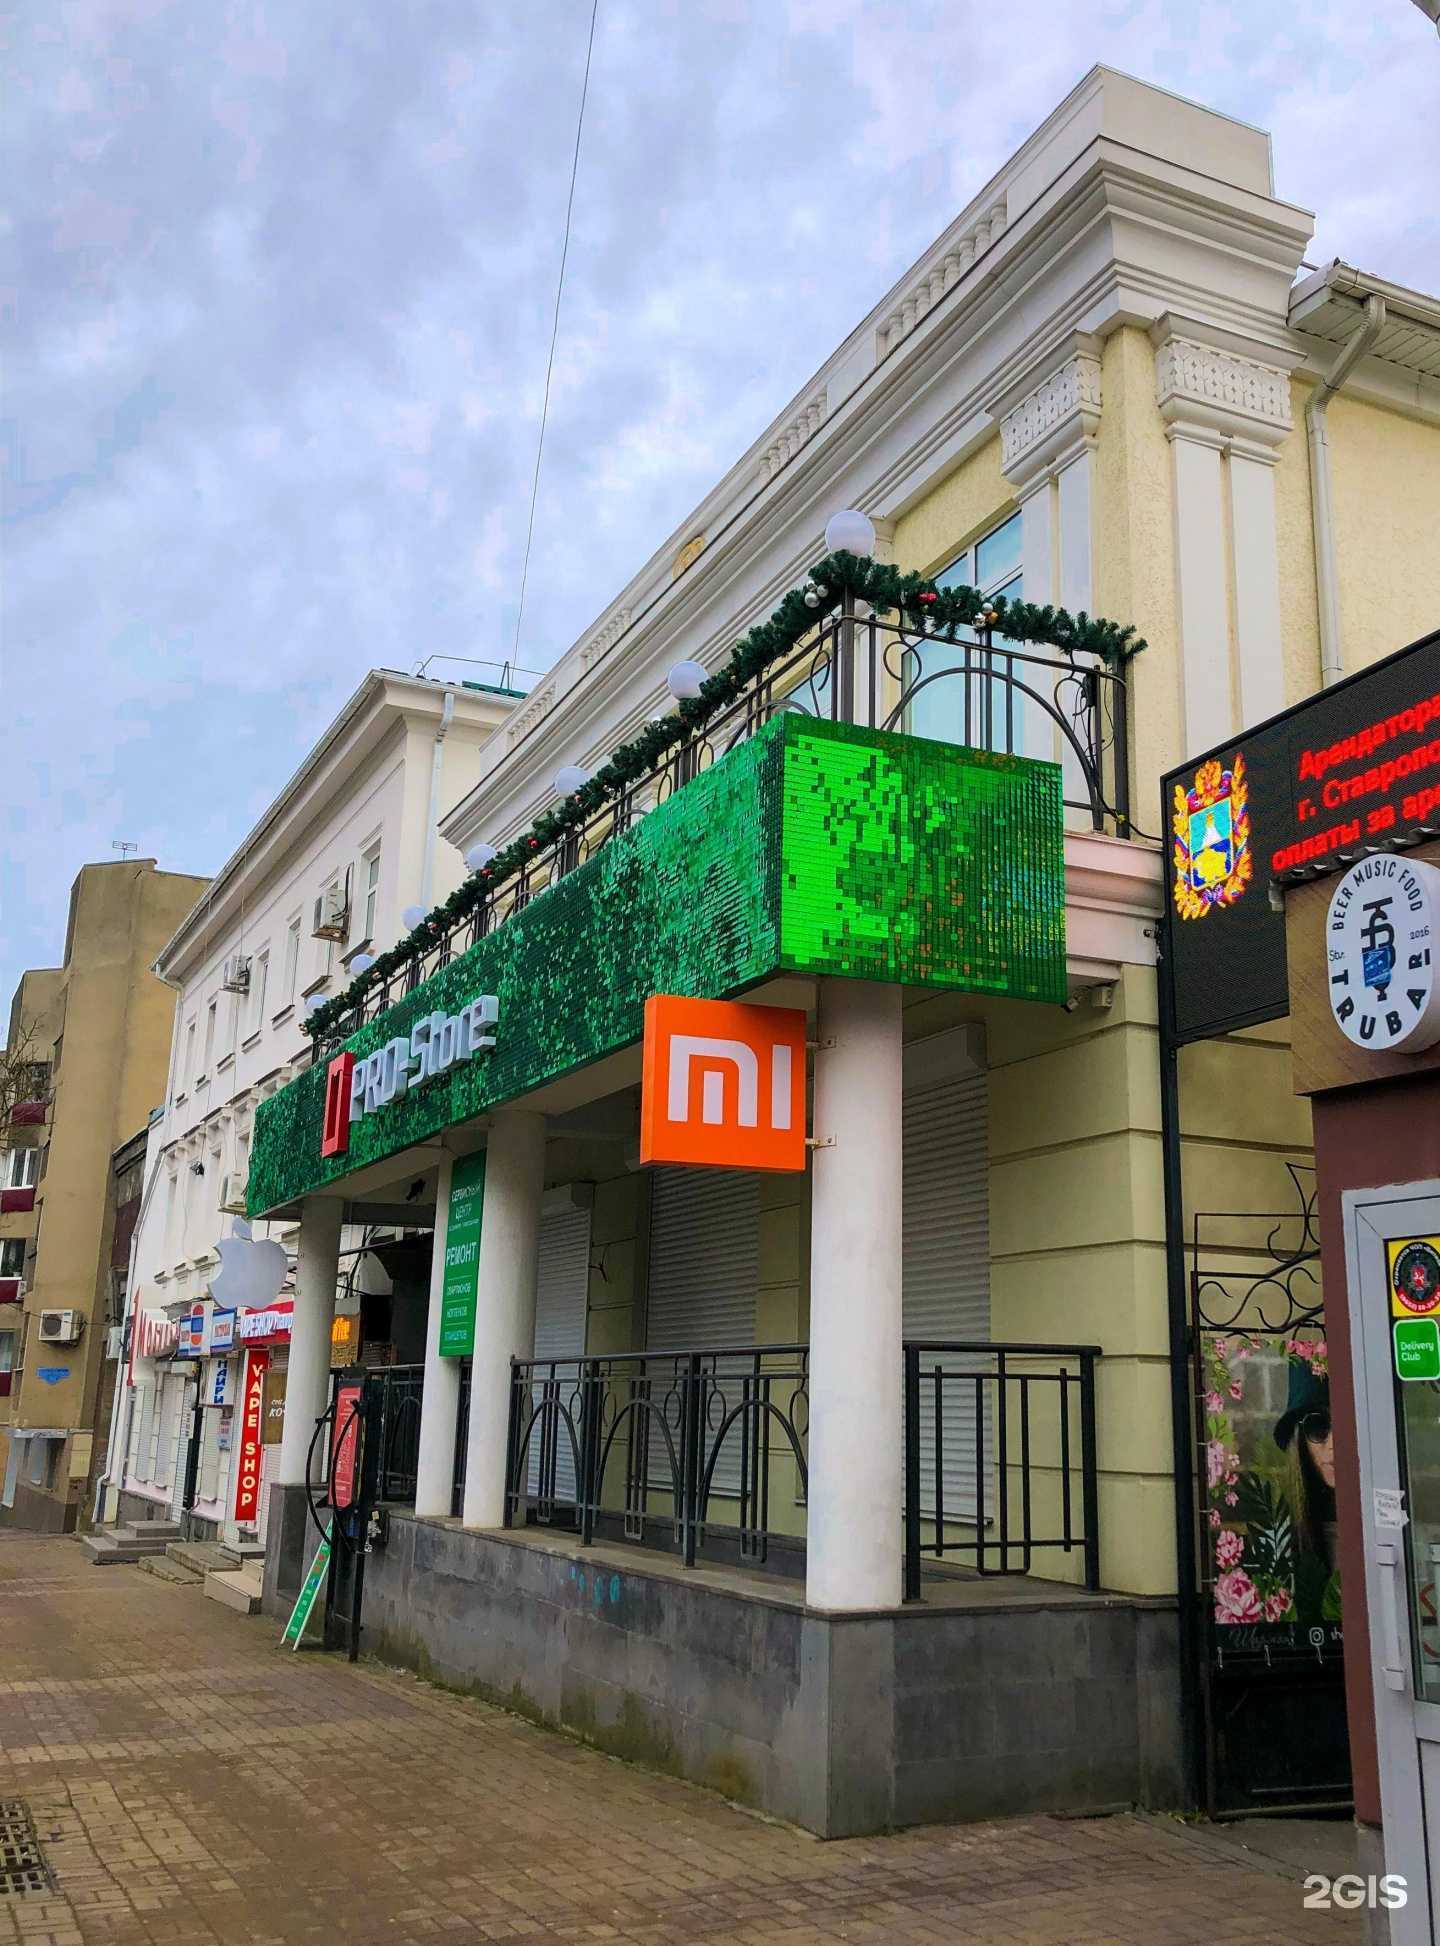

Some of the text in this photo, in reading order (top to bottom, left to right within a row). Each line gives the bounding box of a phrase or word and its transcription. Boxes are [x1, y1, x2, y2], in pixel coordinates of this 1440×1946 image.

[1271, 818, 1361, 872] оплаты
[1366, 804, 1396, 834] за
[1332, 860, 1423, 931] BEER MUSIC FOOD
[1409, 925, 1431, 940] 2016
[446, 1241, 477, 1267] РЕМОНТ
[1400, 1341, 1434, 1352] Delivery
[1401, 1352, 1421, 1361] Club
[248, 1364, 264, 1428] VAPE
[241, 1441, 257, 1507] SHOP
